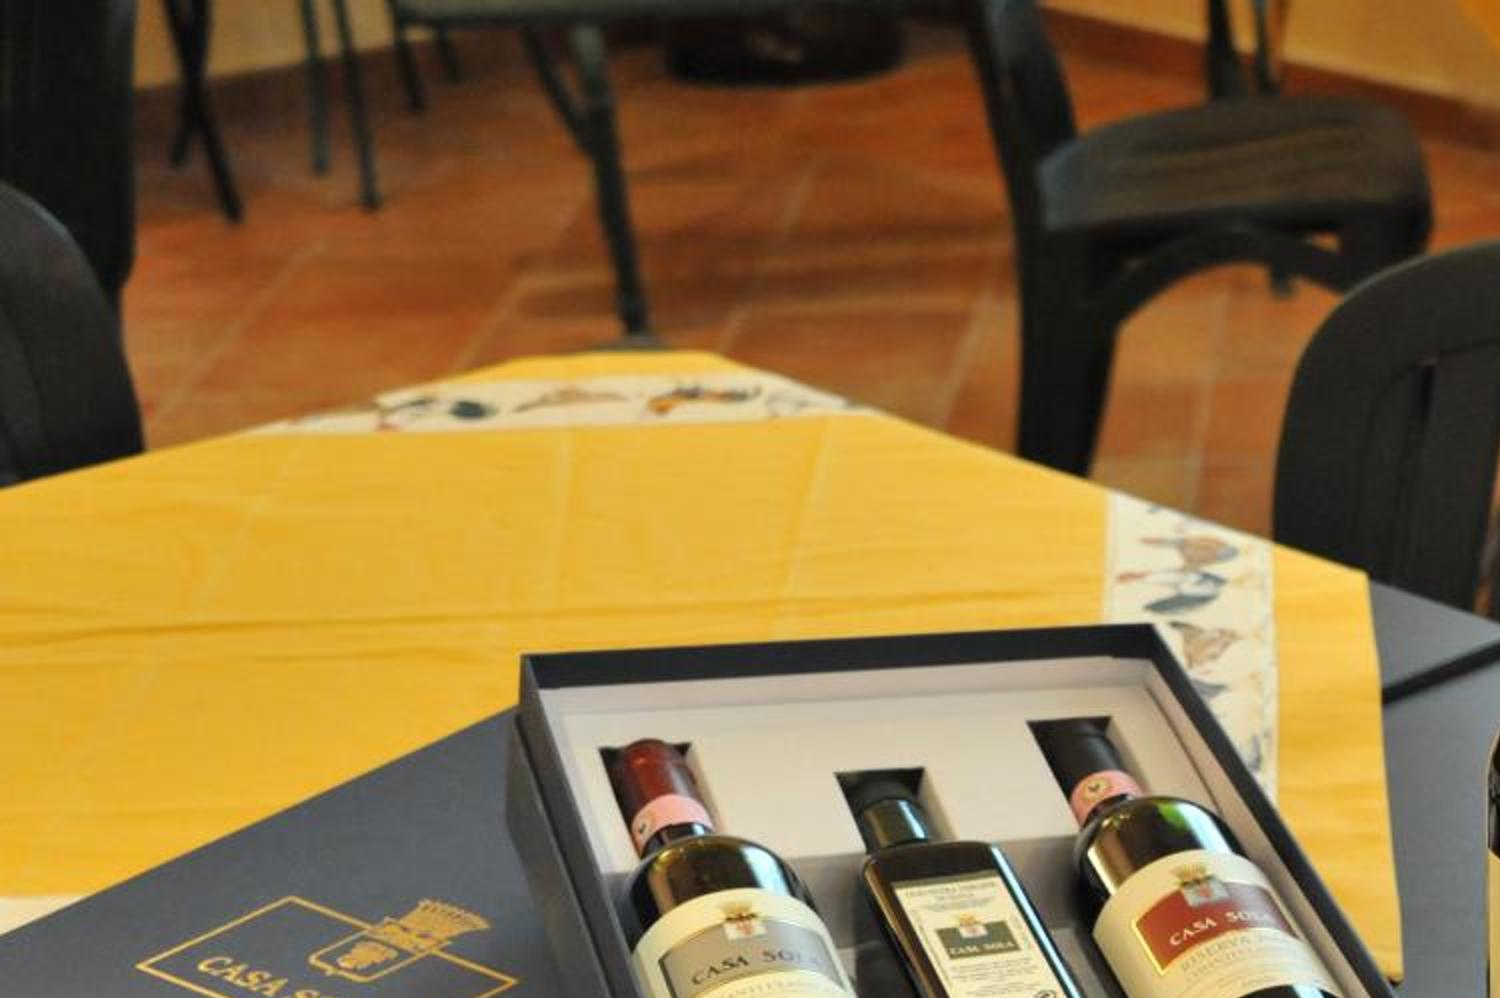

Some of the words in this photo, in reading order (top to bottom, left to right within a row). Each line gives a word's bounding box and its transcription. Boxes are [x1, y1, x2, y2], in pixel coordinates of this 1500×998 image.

[1169, 916, 1218, 946] CASA
[197, 955, 287, 998] CASA
[692, 955, 750, 985] CASA
